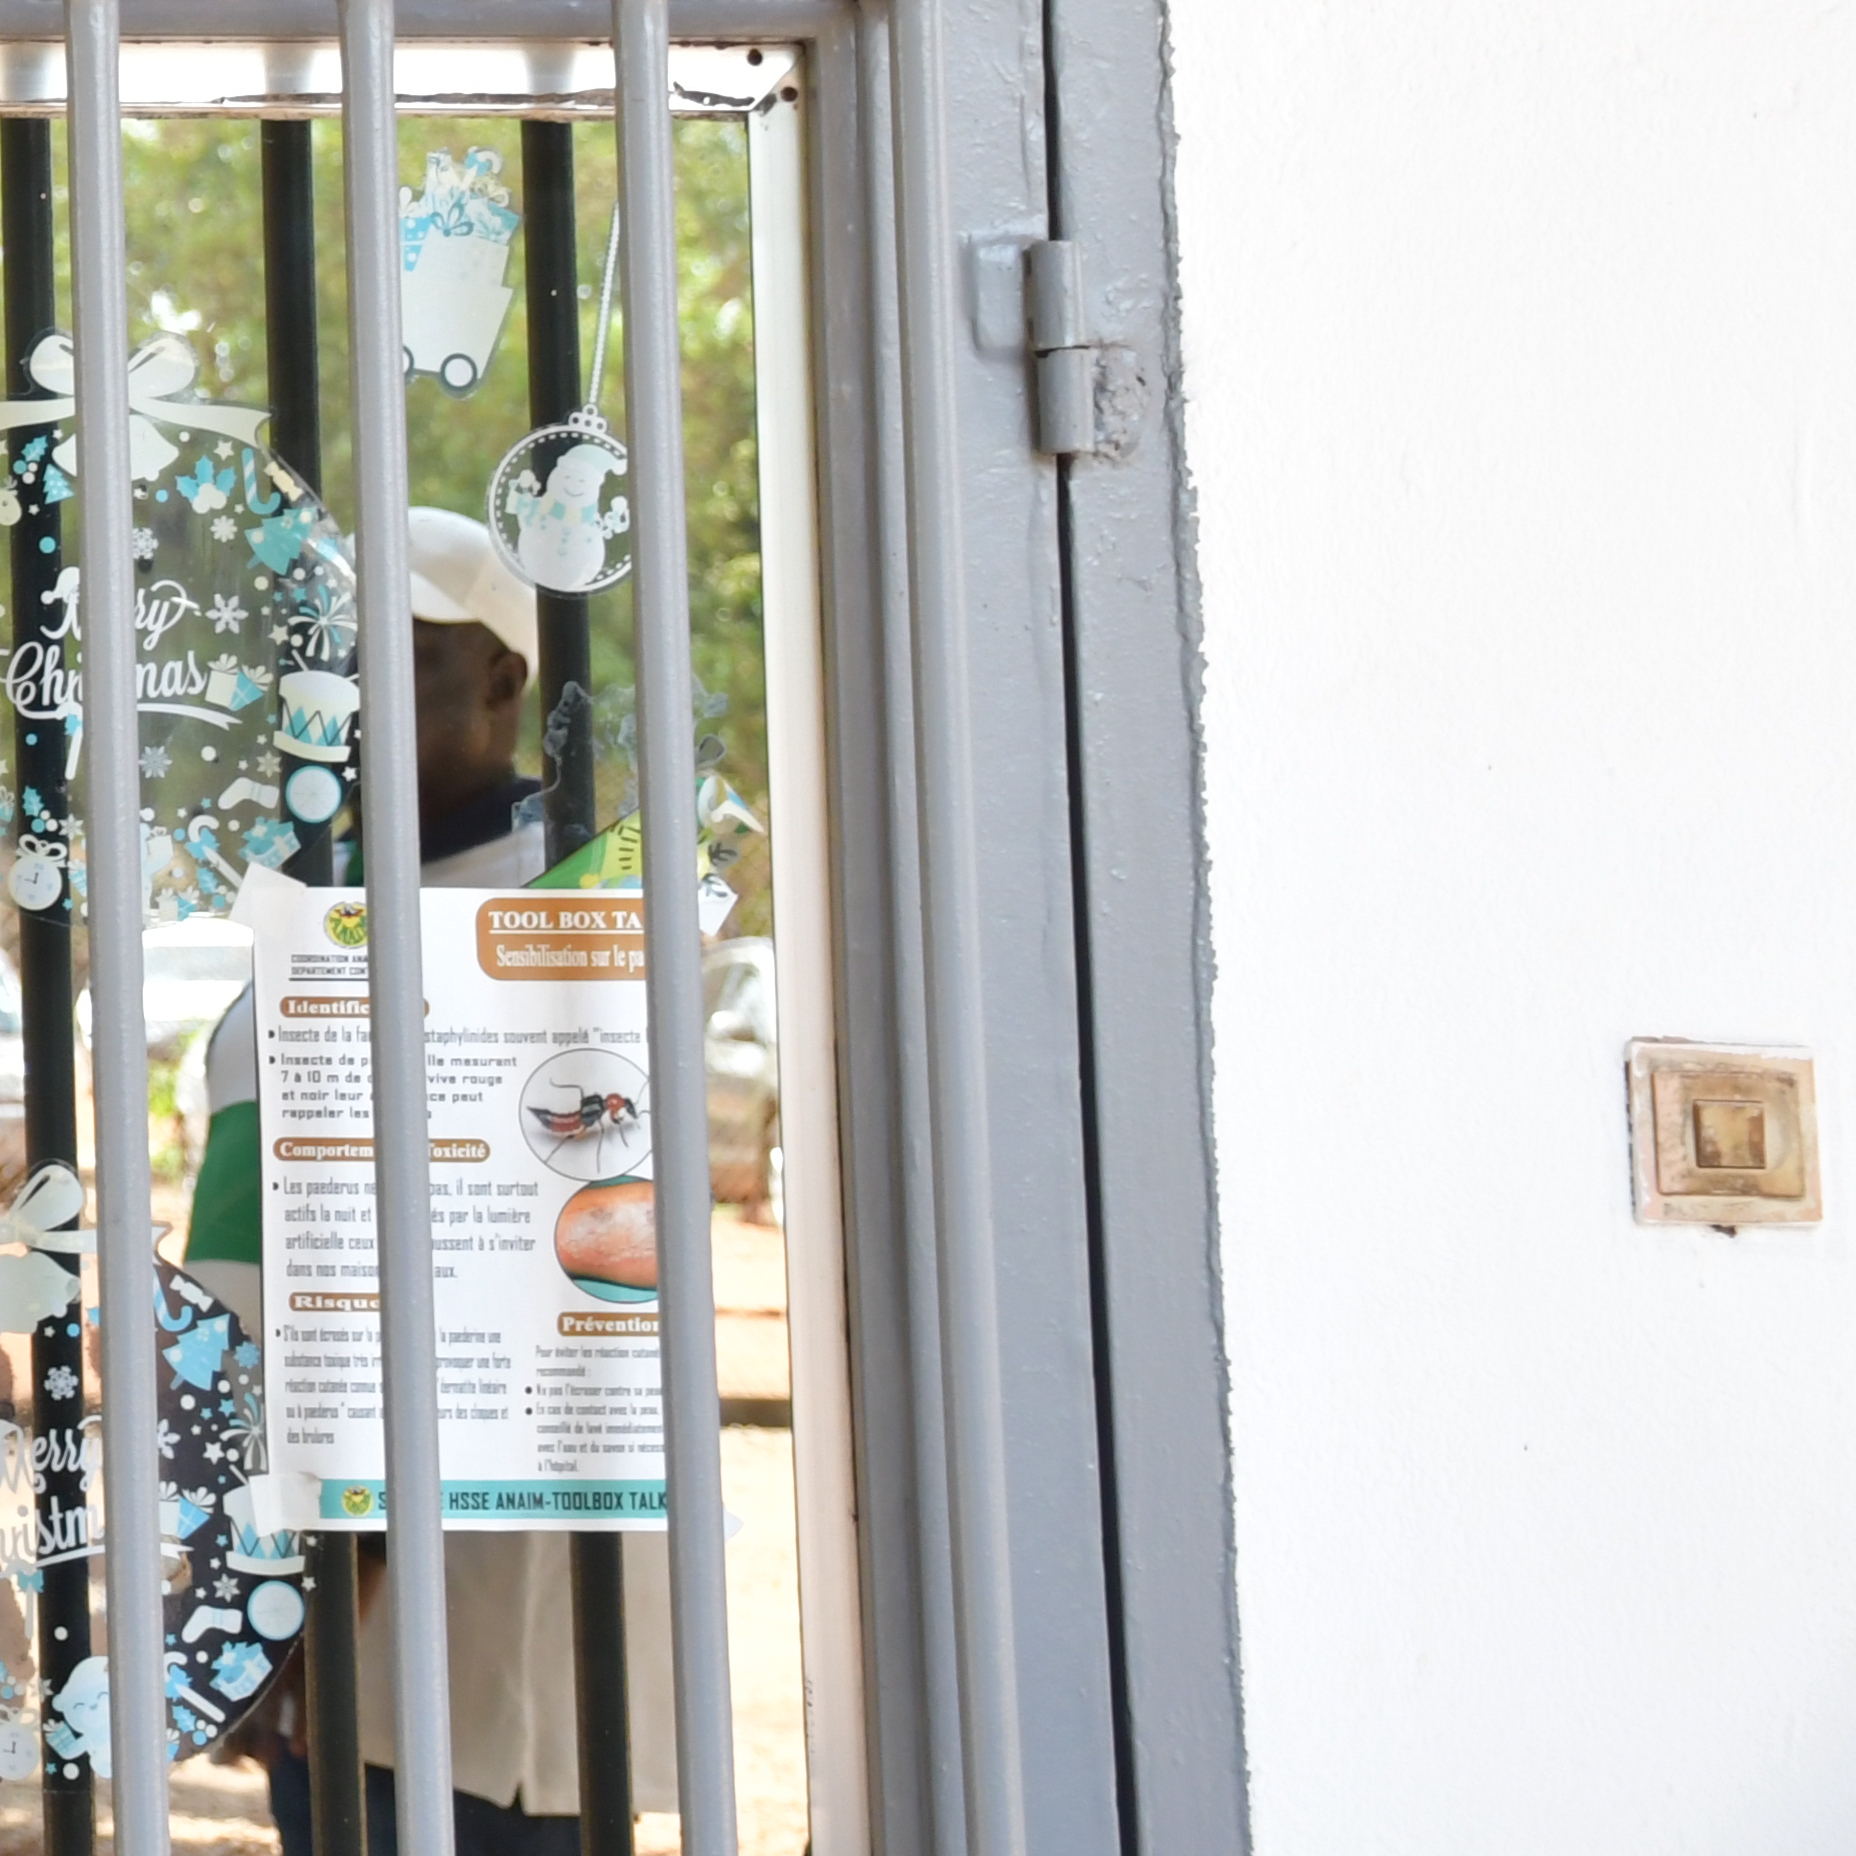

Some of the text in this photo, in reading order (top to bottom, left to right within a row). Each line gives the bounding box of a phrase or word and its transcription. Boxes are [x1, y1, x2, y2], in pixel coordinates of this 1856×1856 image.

[488, 911, 643, 929] TOOL BOX TA
[496, 944, 588, 967] Sensibilisation
[590, 950, 611, 967] sur
[613, 944, 626, 967] le
[288, 1000, 370, 1015] Identific
[278, 1025, 320, 1042] Insecte
[324, 1025, 338, 1042] de
[342, 1025, 352, 1042] la
[503, 1029, 547, 1043] souvent
[280, 1053, 333, 1065] Insecte
[338, 1053, 355, 1065] de
[450, 1056, 517, 1067] mesurant
[280, 1070, 289, 1083] 7
[307, 1070, 321, 1083] 10
[327, 1074, 339, 1083] m
[345, 1071, 361, 1083] de
[462, 1075, 503, 1086] rouge
[281, 1090, 295, 1101] et
[300, 1089, 329, 1101] noir
[334, 1089, 363, 1101] leur
[452, 1091, 483, 1104] peut
[282, 1106, 370, 1120] rappeler les
[279, 1141, 374, 1160] Comportem
[283, 1176, 303, 1195] Les
[306, 1176, 359, 1198] paederus
[456, 1177, 463, 1195] il
[467, 1181, 492, 1196] sont
[496, 1181, 538, 1196] surtout
[284, 1203, 316, 1222] actifs
[320, 1203, 331, 1222] la
[334, 1206, 356, 1222] nuit
[360, 1207, 372, 1222] et
[449, 1211, 469, 1226] par
[473, 1204, 483, 1223] la
[487, 1204, 530, 1223] lumière
[285, 1231, 344, 1250] artificielle
[489, 1232, 536, 1251] s'inviter
[286, 1258, 312, 1277] dans
[316, 1265, 336, 1277] nos
[449, 1490, 490, 1511] HSSE
[495, 1490, 624, 1511] ANAIM-TOOLBOX
[629, 1491, 668, 1511] TALK
